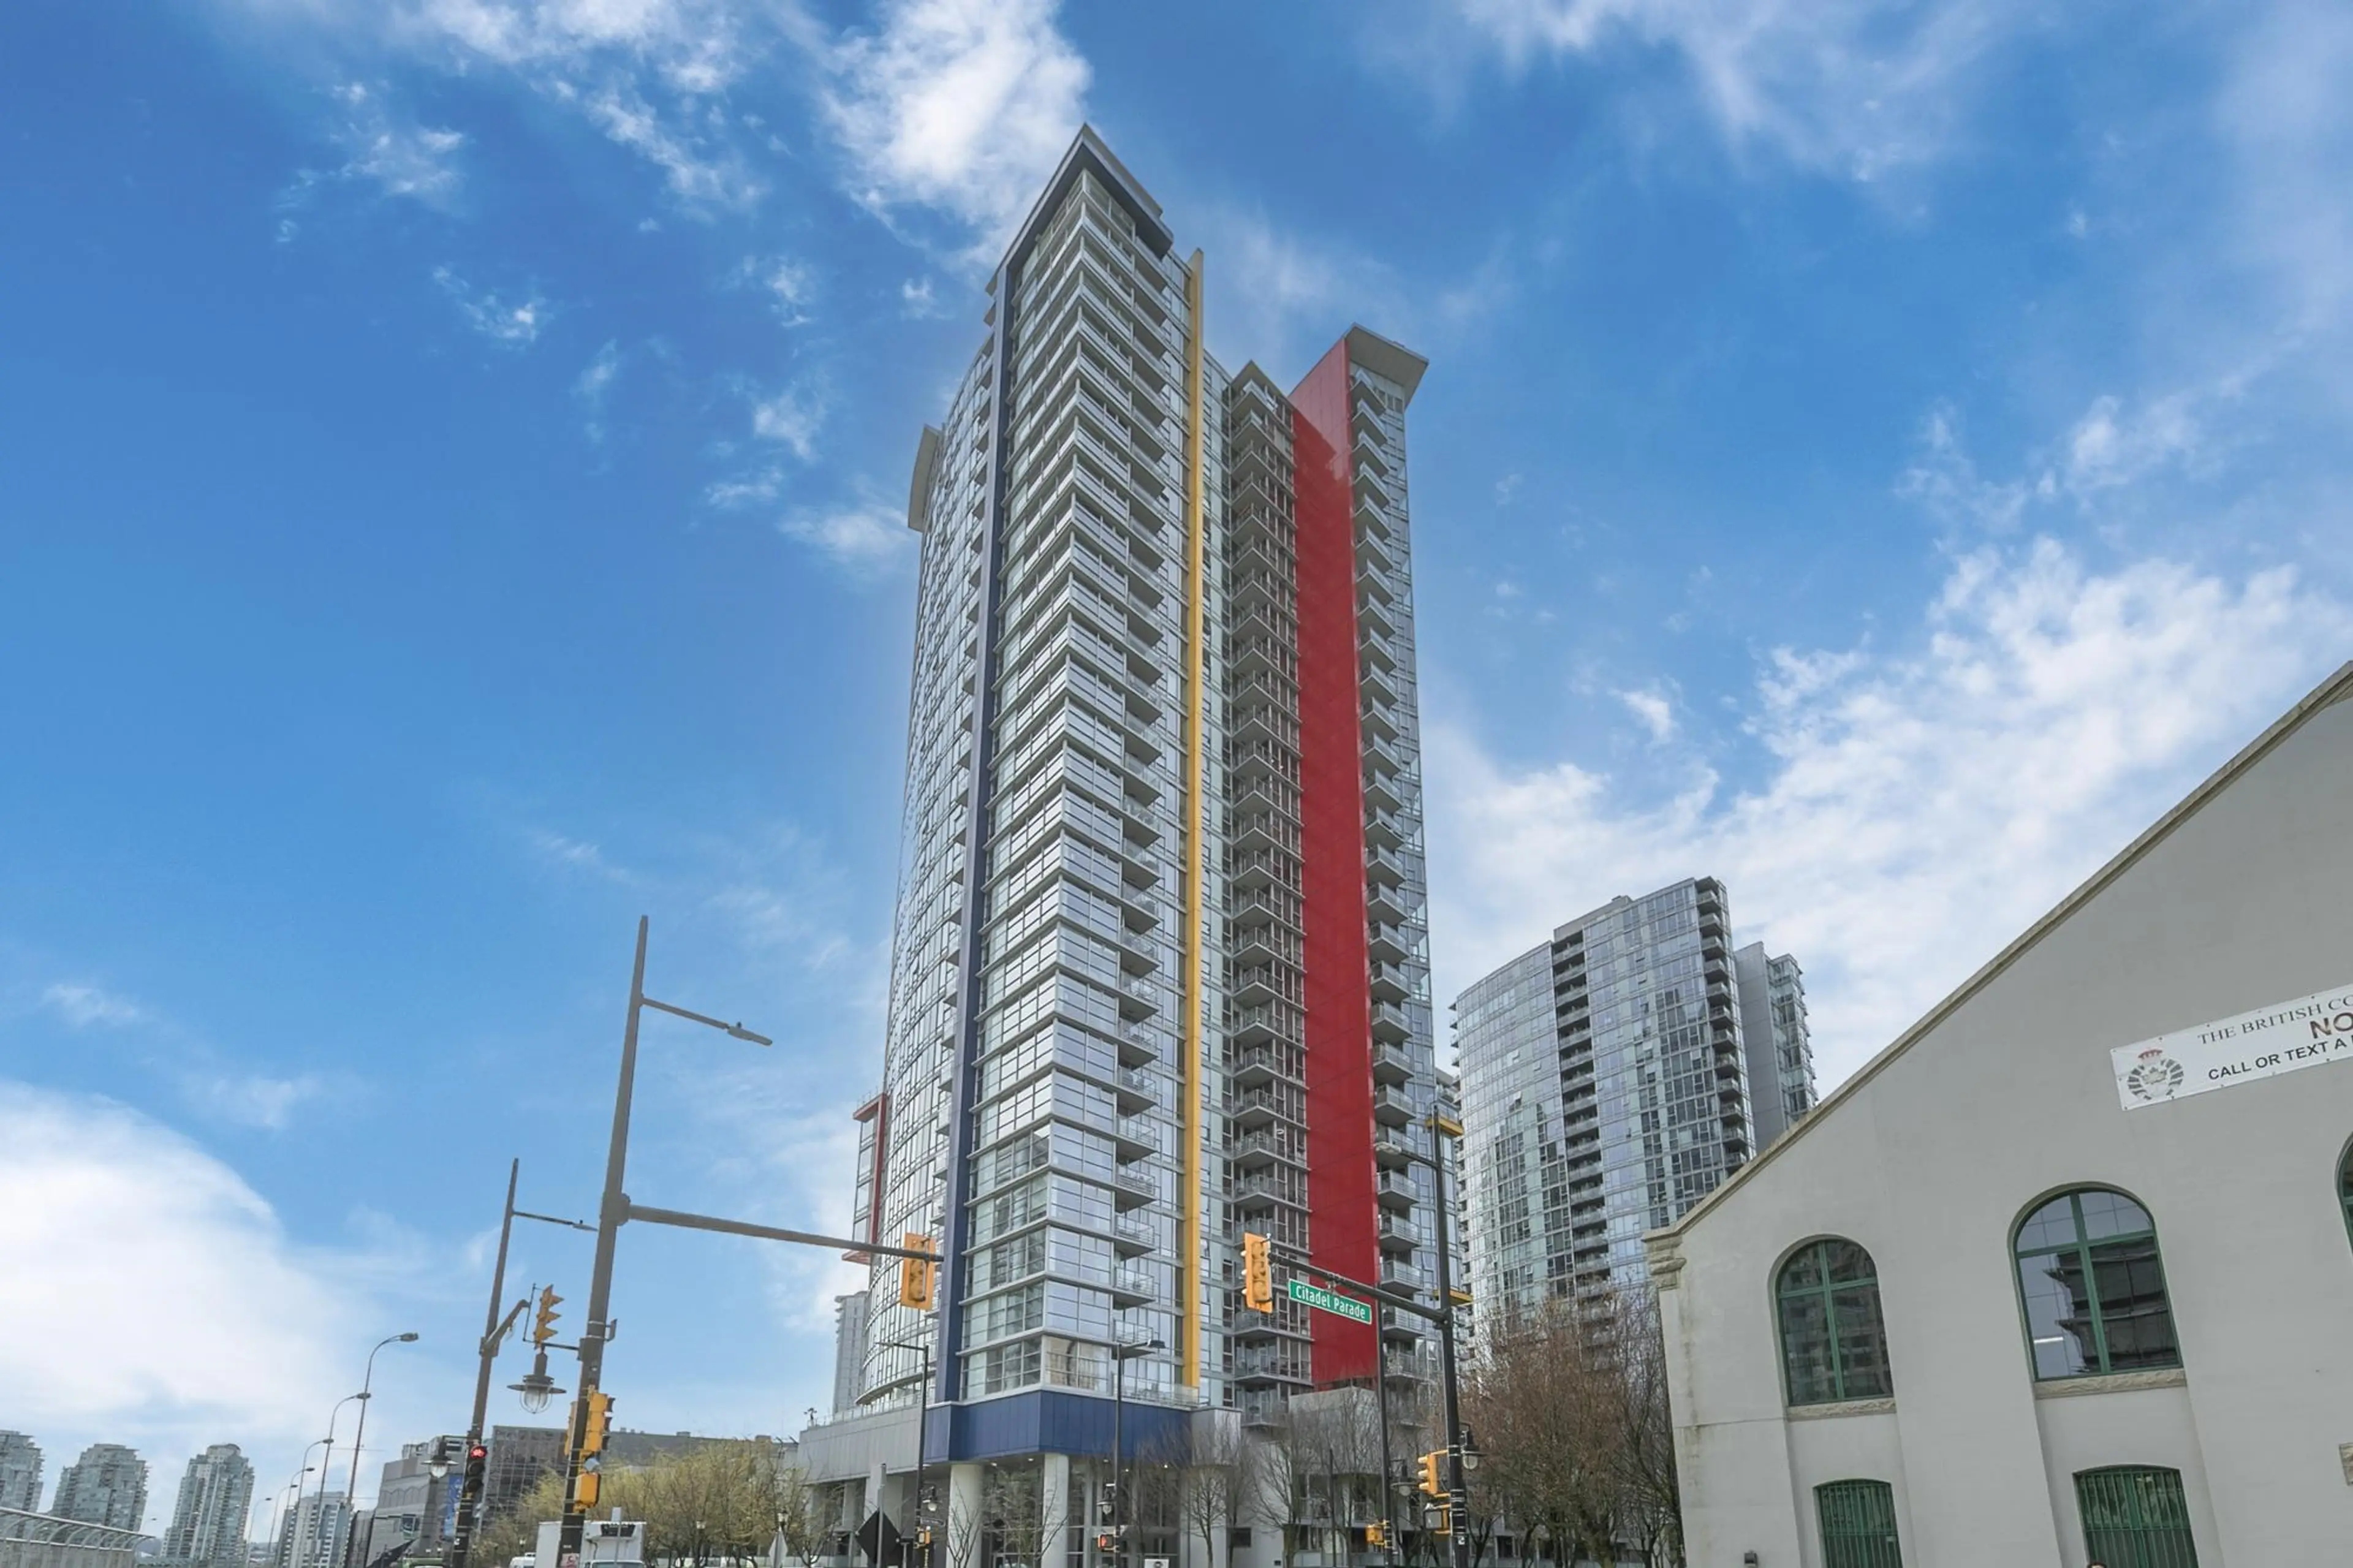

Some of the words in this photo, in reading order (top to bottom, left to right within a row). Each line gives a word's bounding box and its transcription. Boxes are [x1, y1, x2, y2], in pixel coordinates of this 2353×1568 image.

[2197, 1026, 2237, 1044] THE
[2241, 1003, 2322, 1034] BRITISH
[2309, 1012, 2353, 1039] NO
[2208, 1061, 2251, 1080] CALL
[2256, 1053, 2281, 1068] OR
[2284, 1040, 2328, 1061] TEXT
[2335, 1037, 2347, 1050] A
[1296, 1285, 1330, 1308] Citadel
[1333, 1297, 1366, 1319] Parade
